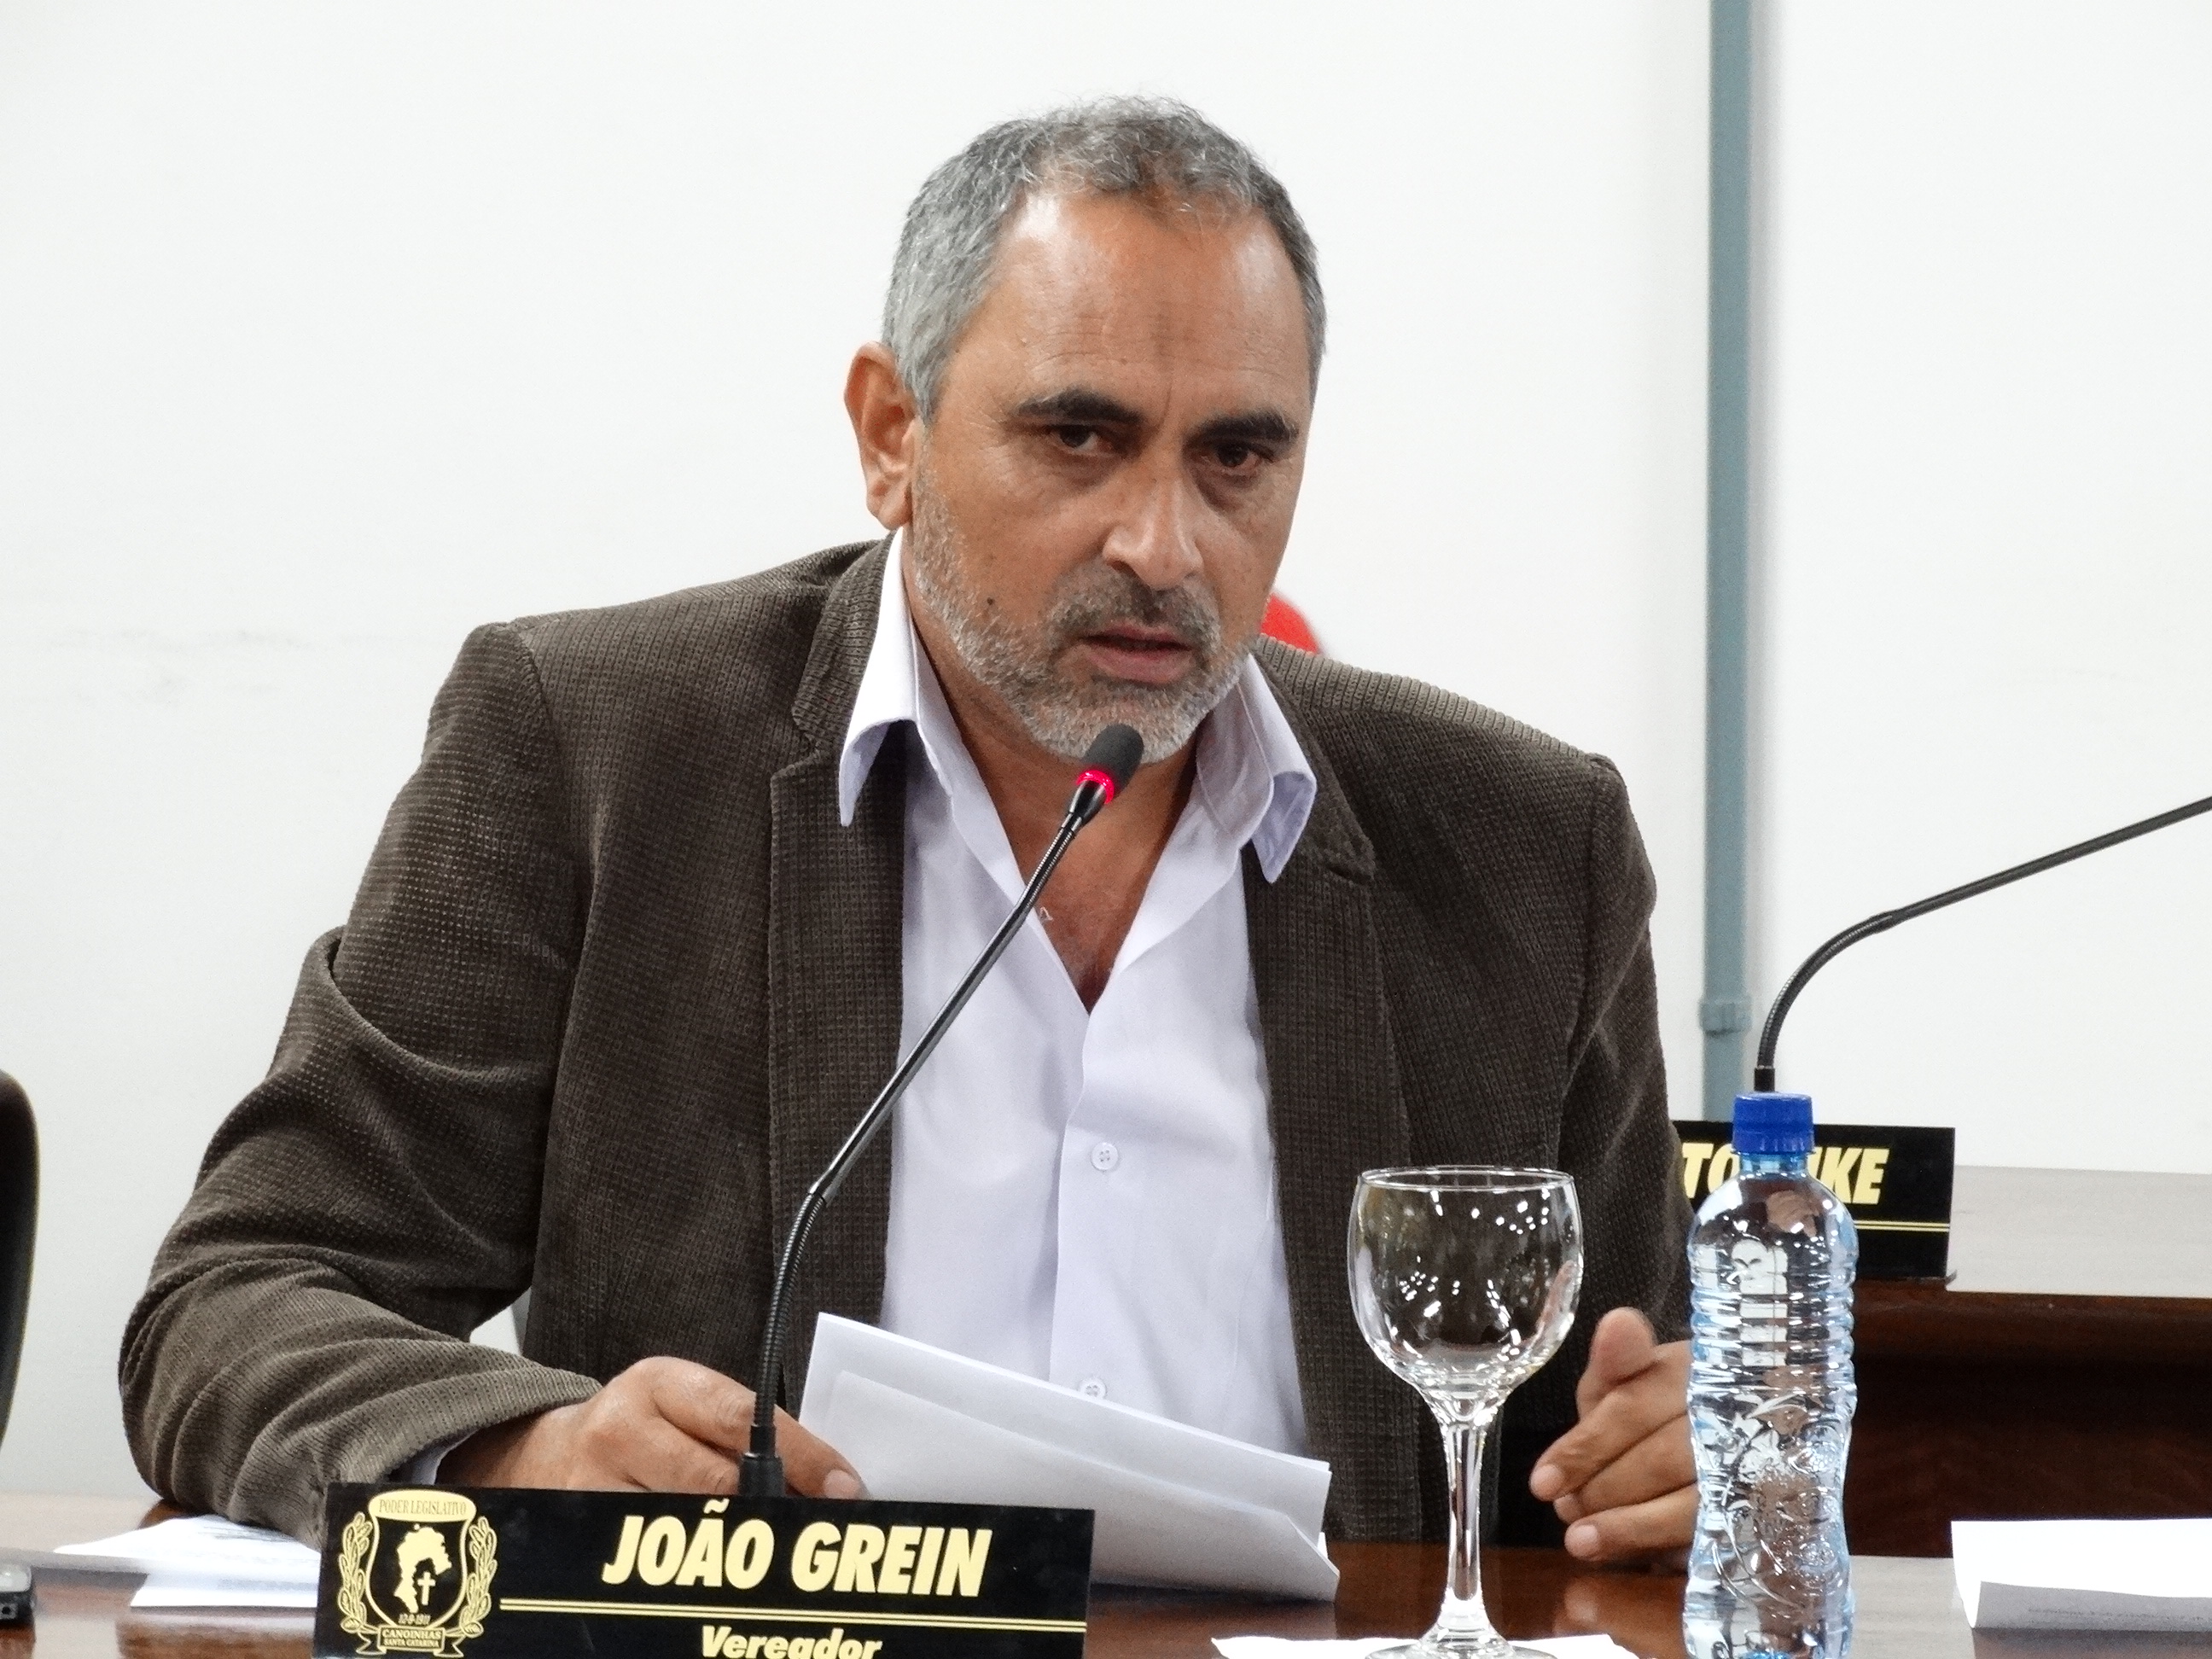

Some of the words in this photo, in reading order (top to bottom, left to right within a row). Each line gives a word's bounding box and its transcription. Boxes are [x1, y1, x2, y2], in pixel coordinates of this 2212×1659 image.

[1805, 1145, 1890, 1206] IKE
[378, 1499, 410, 1514] PODER
[410, 1499, 468, 1516] LEGISLATIVO
[602, 1499, 775, 1590] JOÃO
[790, 1522, 992, 1598] GREIN
[381, 1628, 442, 1640] CANOINHAS
[383, 1638, 406, 1647] SANTA
[701, 1625, 883, 1659] Vereador
